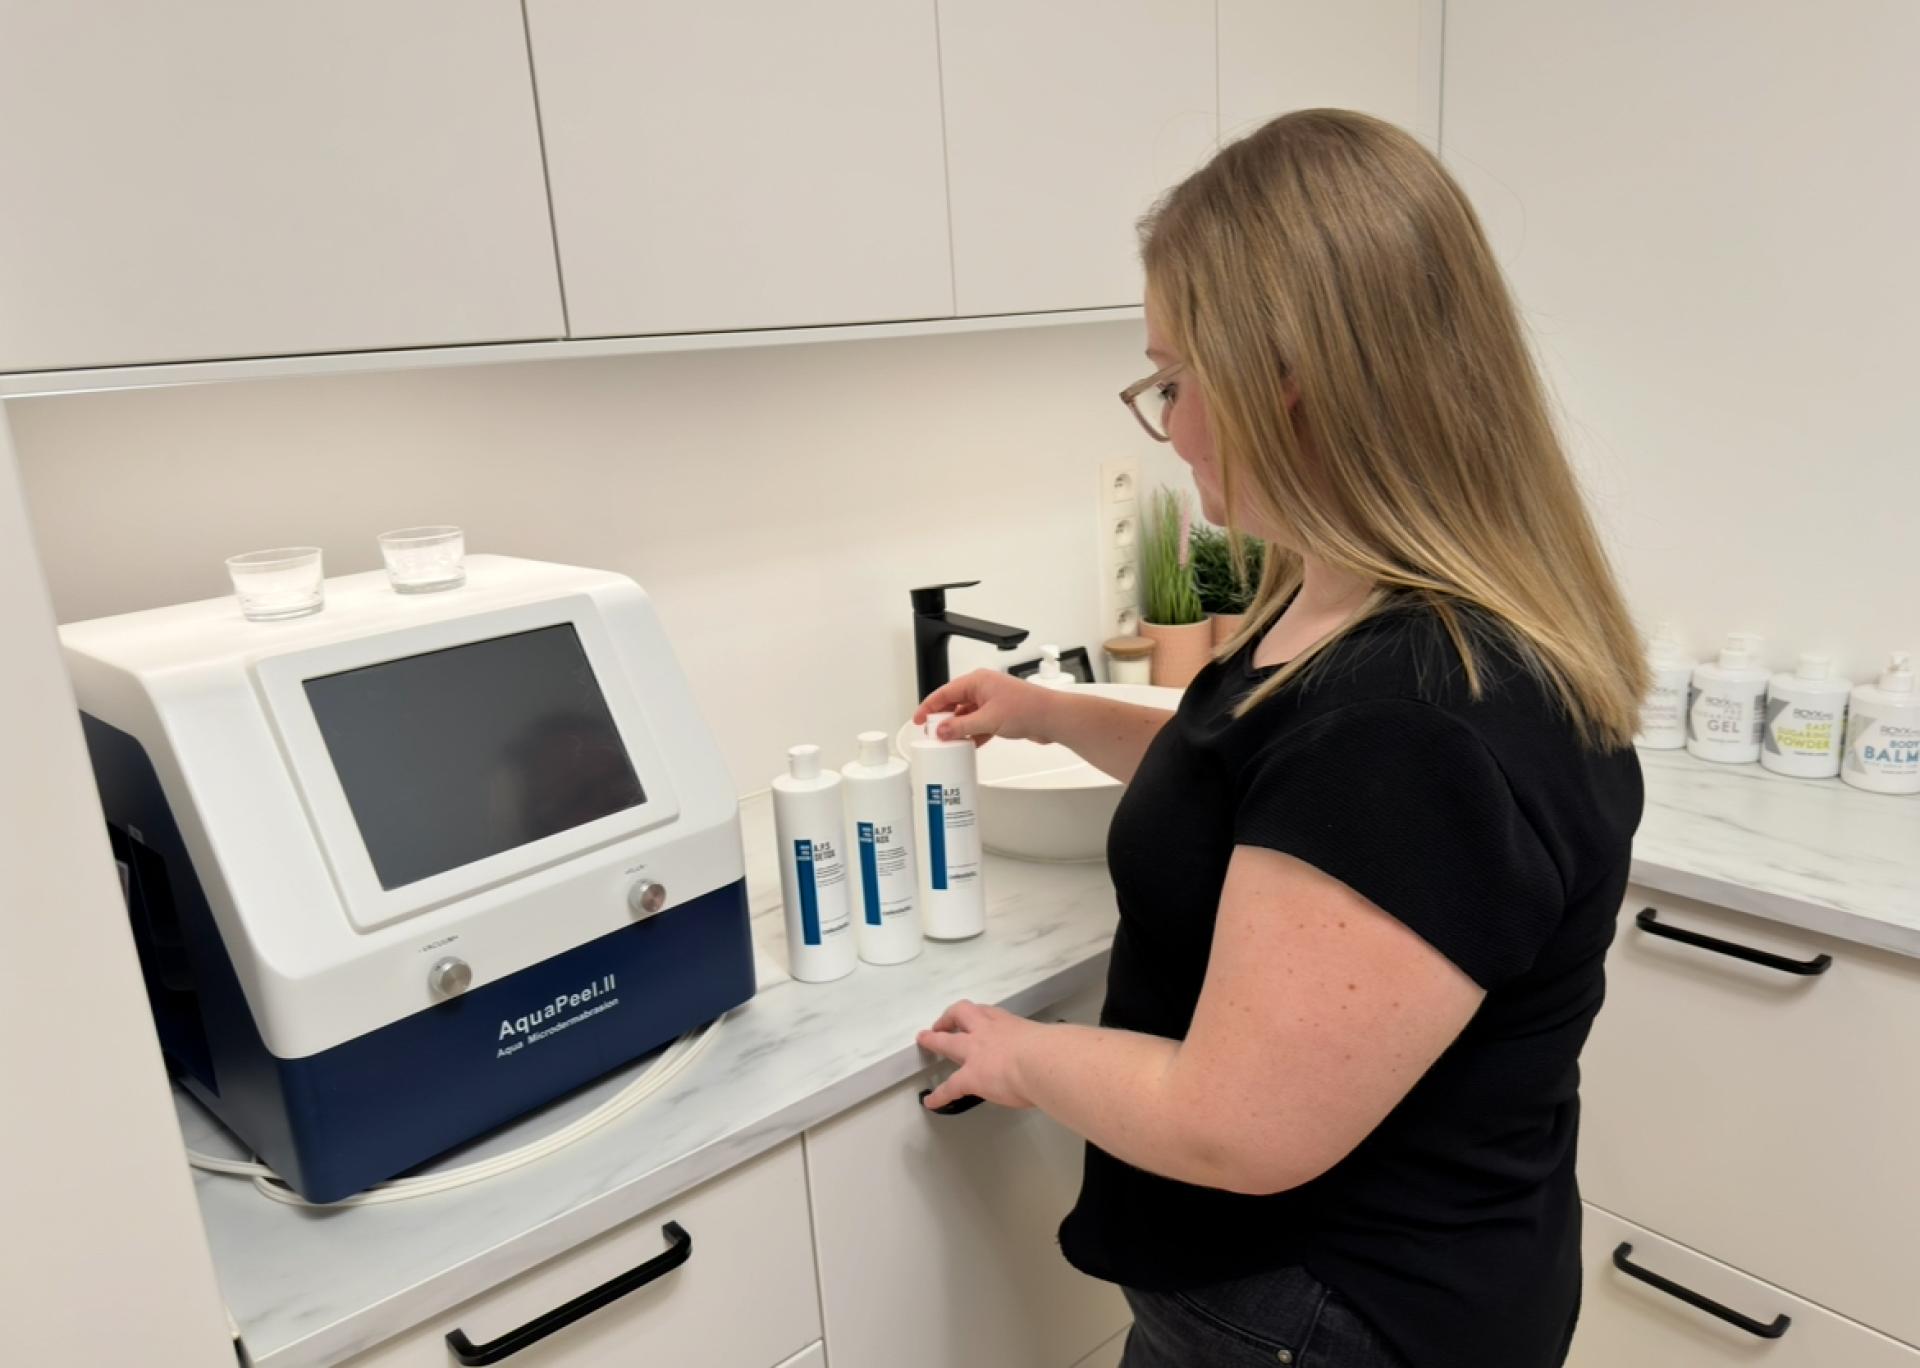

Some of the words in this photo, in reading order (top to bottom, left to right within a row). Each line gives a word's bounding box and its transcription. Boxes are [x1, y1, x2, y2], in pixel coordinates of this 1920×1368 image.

[1707, 719, 1740, 733] GEL
[1777, 735, 1830, 749] POWDER
[1864, 745, 1919, 762] BALM
[498, 974, 617, 1041] AquaPeel.II
[496, 1040, 525, 1059] Aqua
[527, 997, 620, 1044] Microdermabrasion
